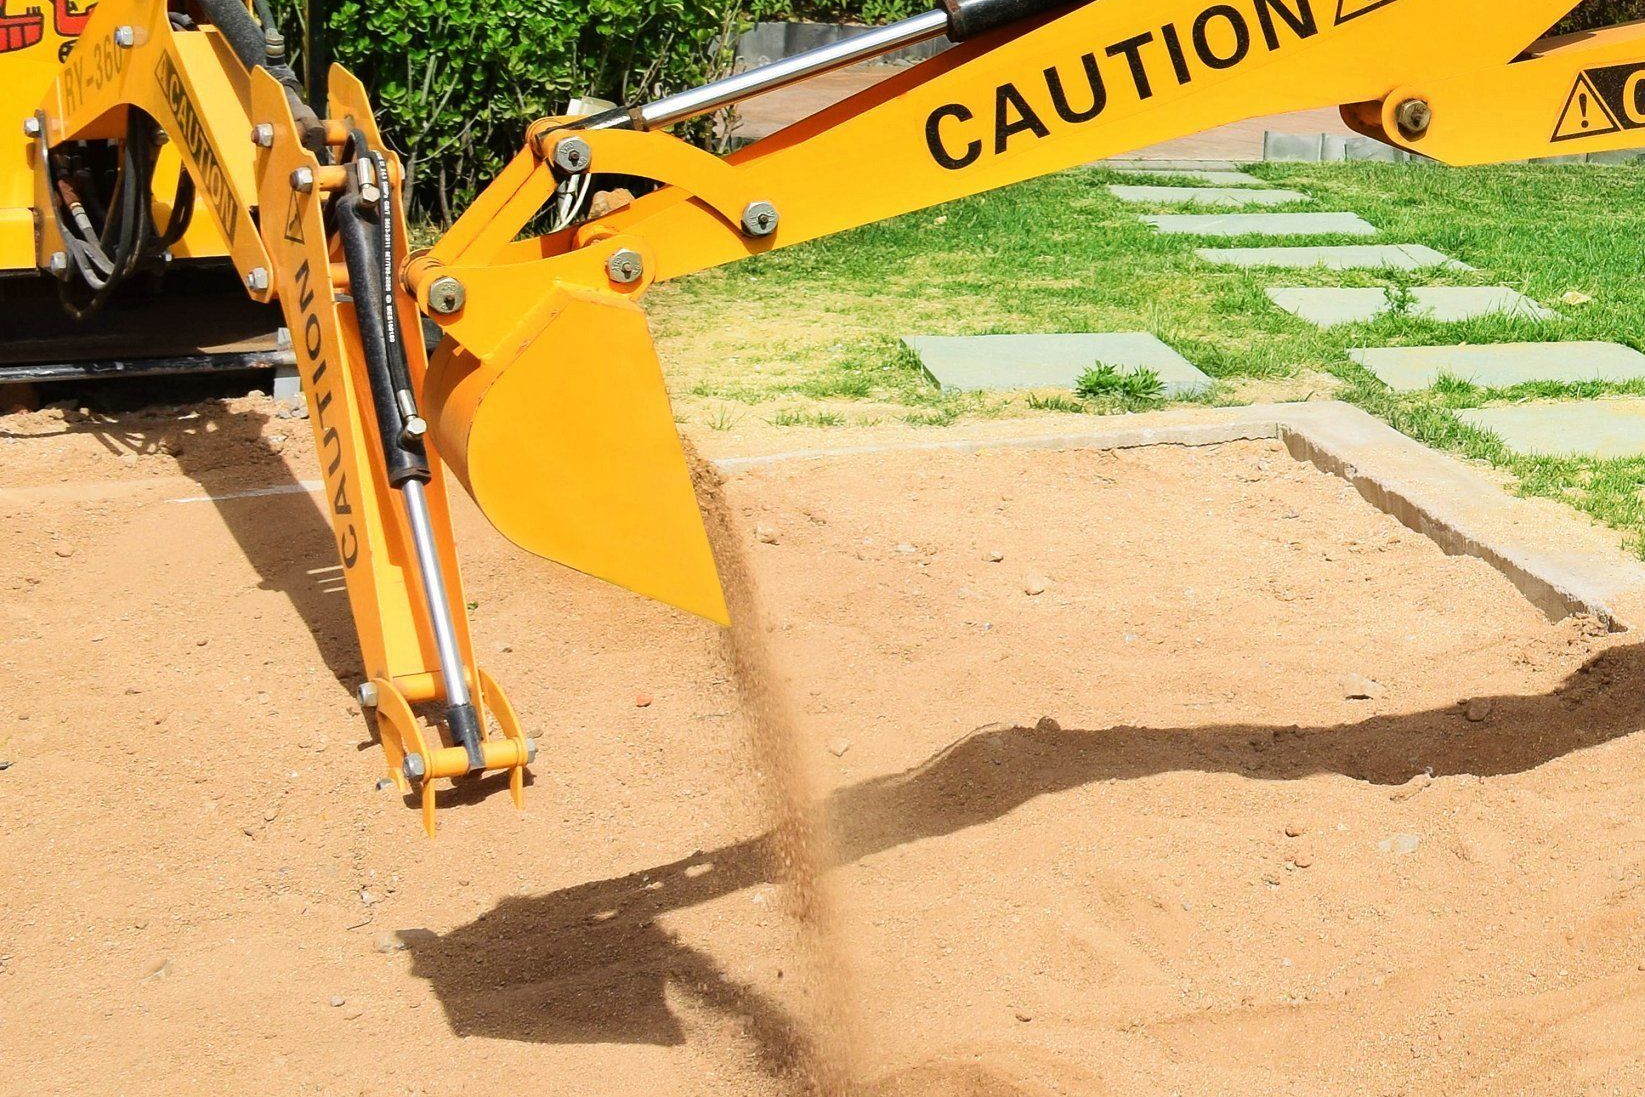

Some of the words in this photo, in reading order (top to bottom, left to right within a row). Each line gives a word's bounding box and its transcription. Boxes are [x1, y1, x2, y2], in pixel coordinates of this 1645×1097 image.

[64, 33, 124, 116] RY-360
[168, 74, 234, 232] CAUTION
[294, 258, 361, 570] CAUTION
